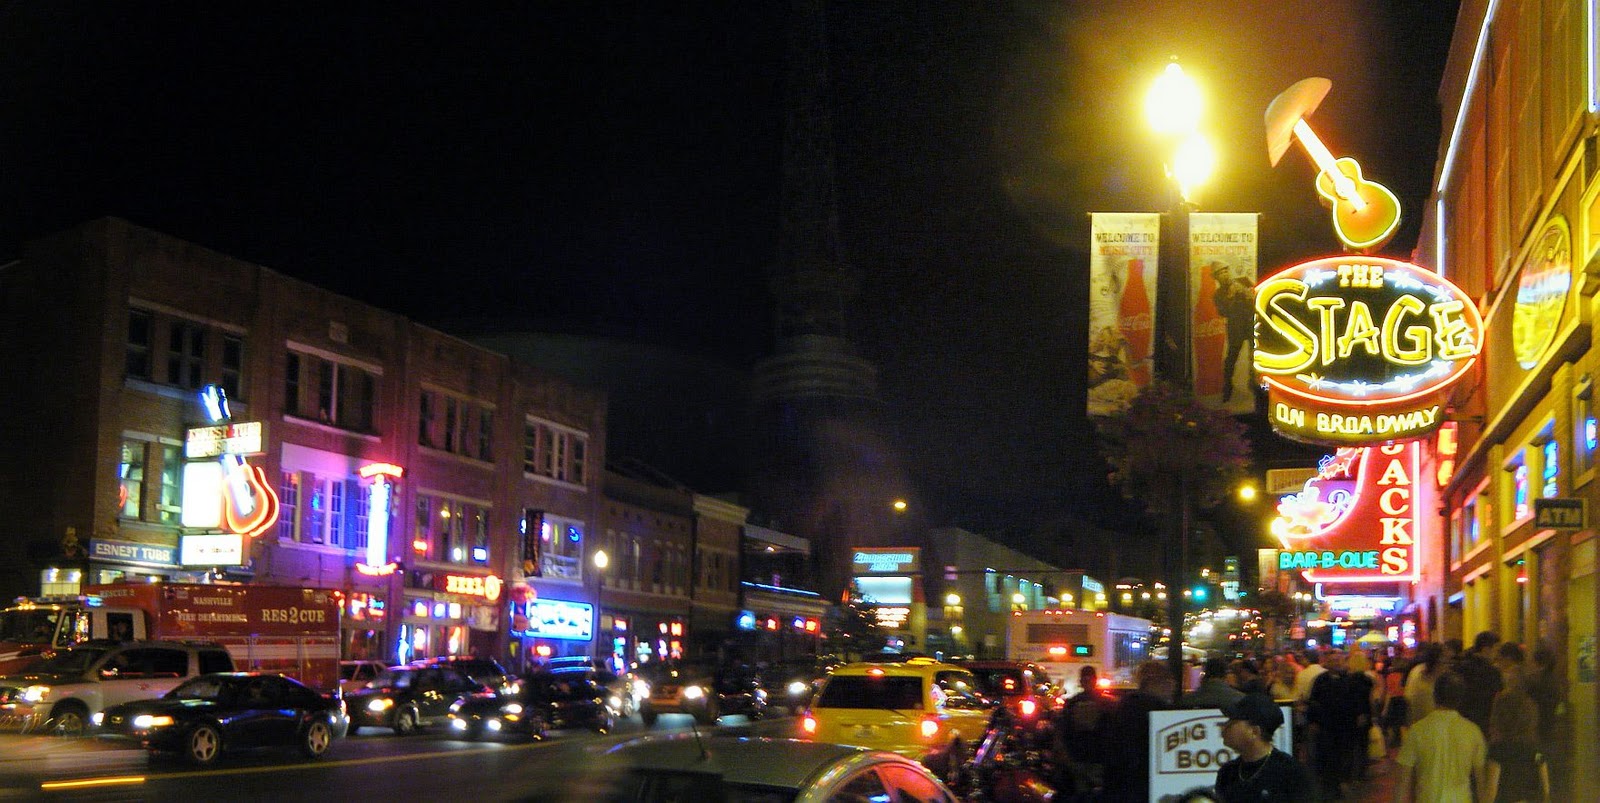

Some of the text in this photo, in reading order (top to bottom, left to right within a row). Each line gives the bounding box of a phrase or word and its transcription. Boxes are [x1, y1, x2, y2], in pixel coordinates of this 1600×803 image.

[1095, 232, 1155, 243] WELCOME TO
[1192, 232, 1239, 243] WELCOME
[1337, 264, 1384, 288] THE
[1253, 278, 1478, 375] STAGE
[1275, 402, 1440, 434] ON BROADWAY
[1539, 507, 1584, 524] ATM
[95, 543, 171, 562] ERNEST TUBB
[1279, 551, 1380, 569] BAR-B-QUE
[193, 597, 233, 606] NASHVILLE
[1165, 723, 1206, 752] BIG
[1177, 748, 1232, 769] BOO
